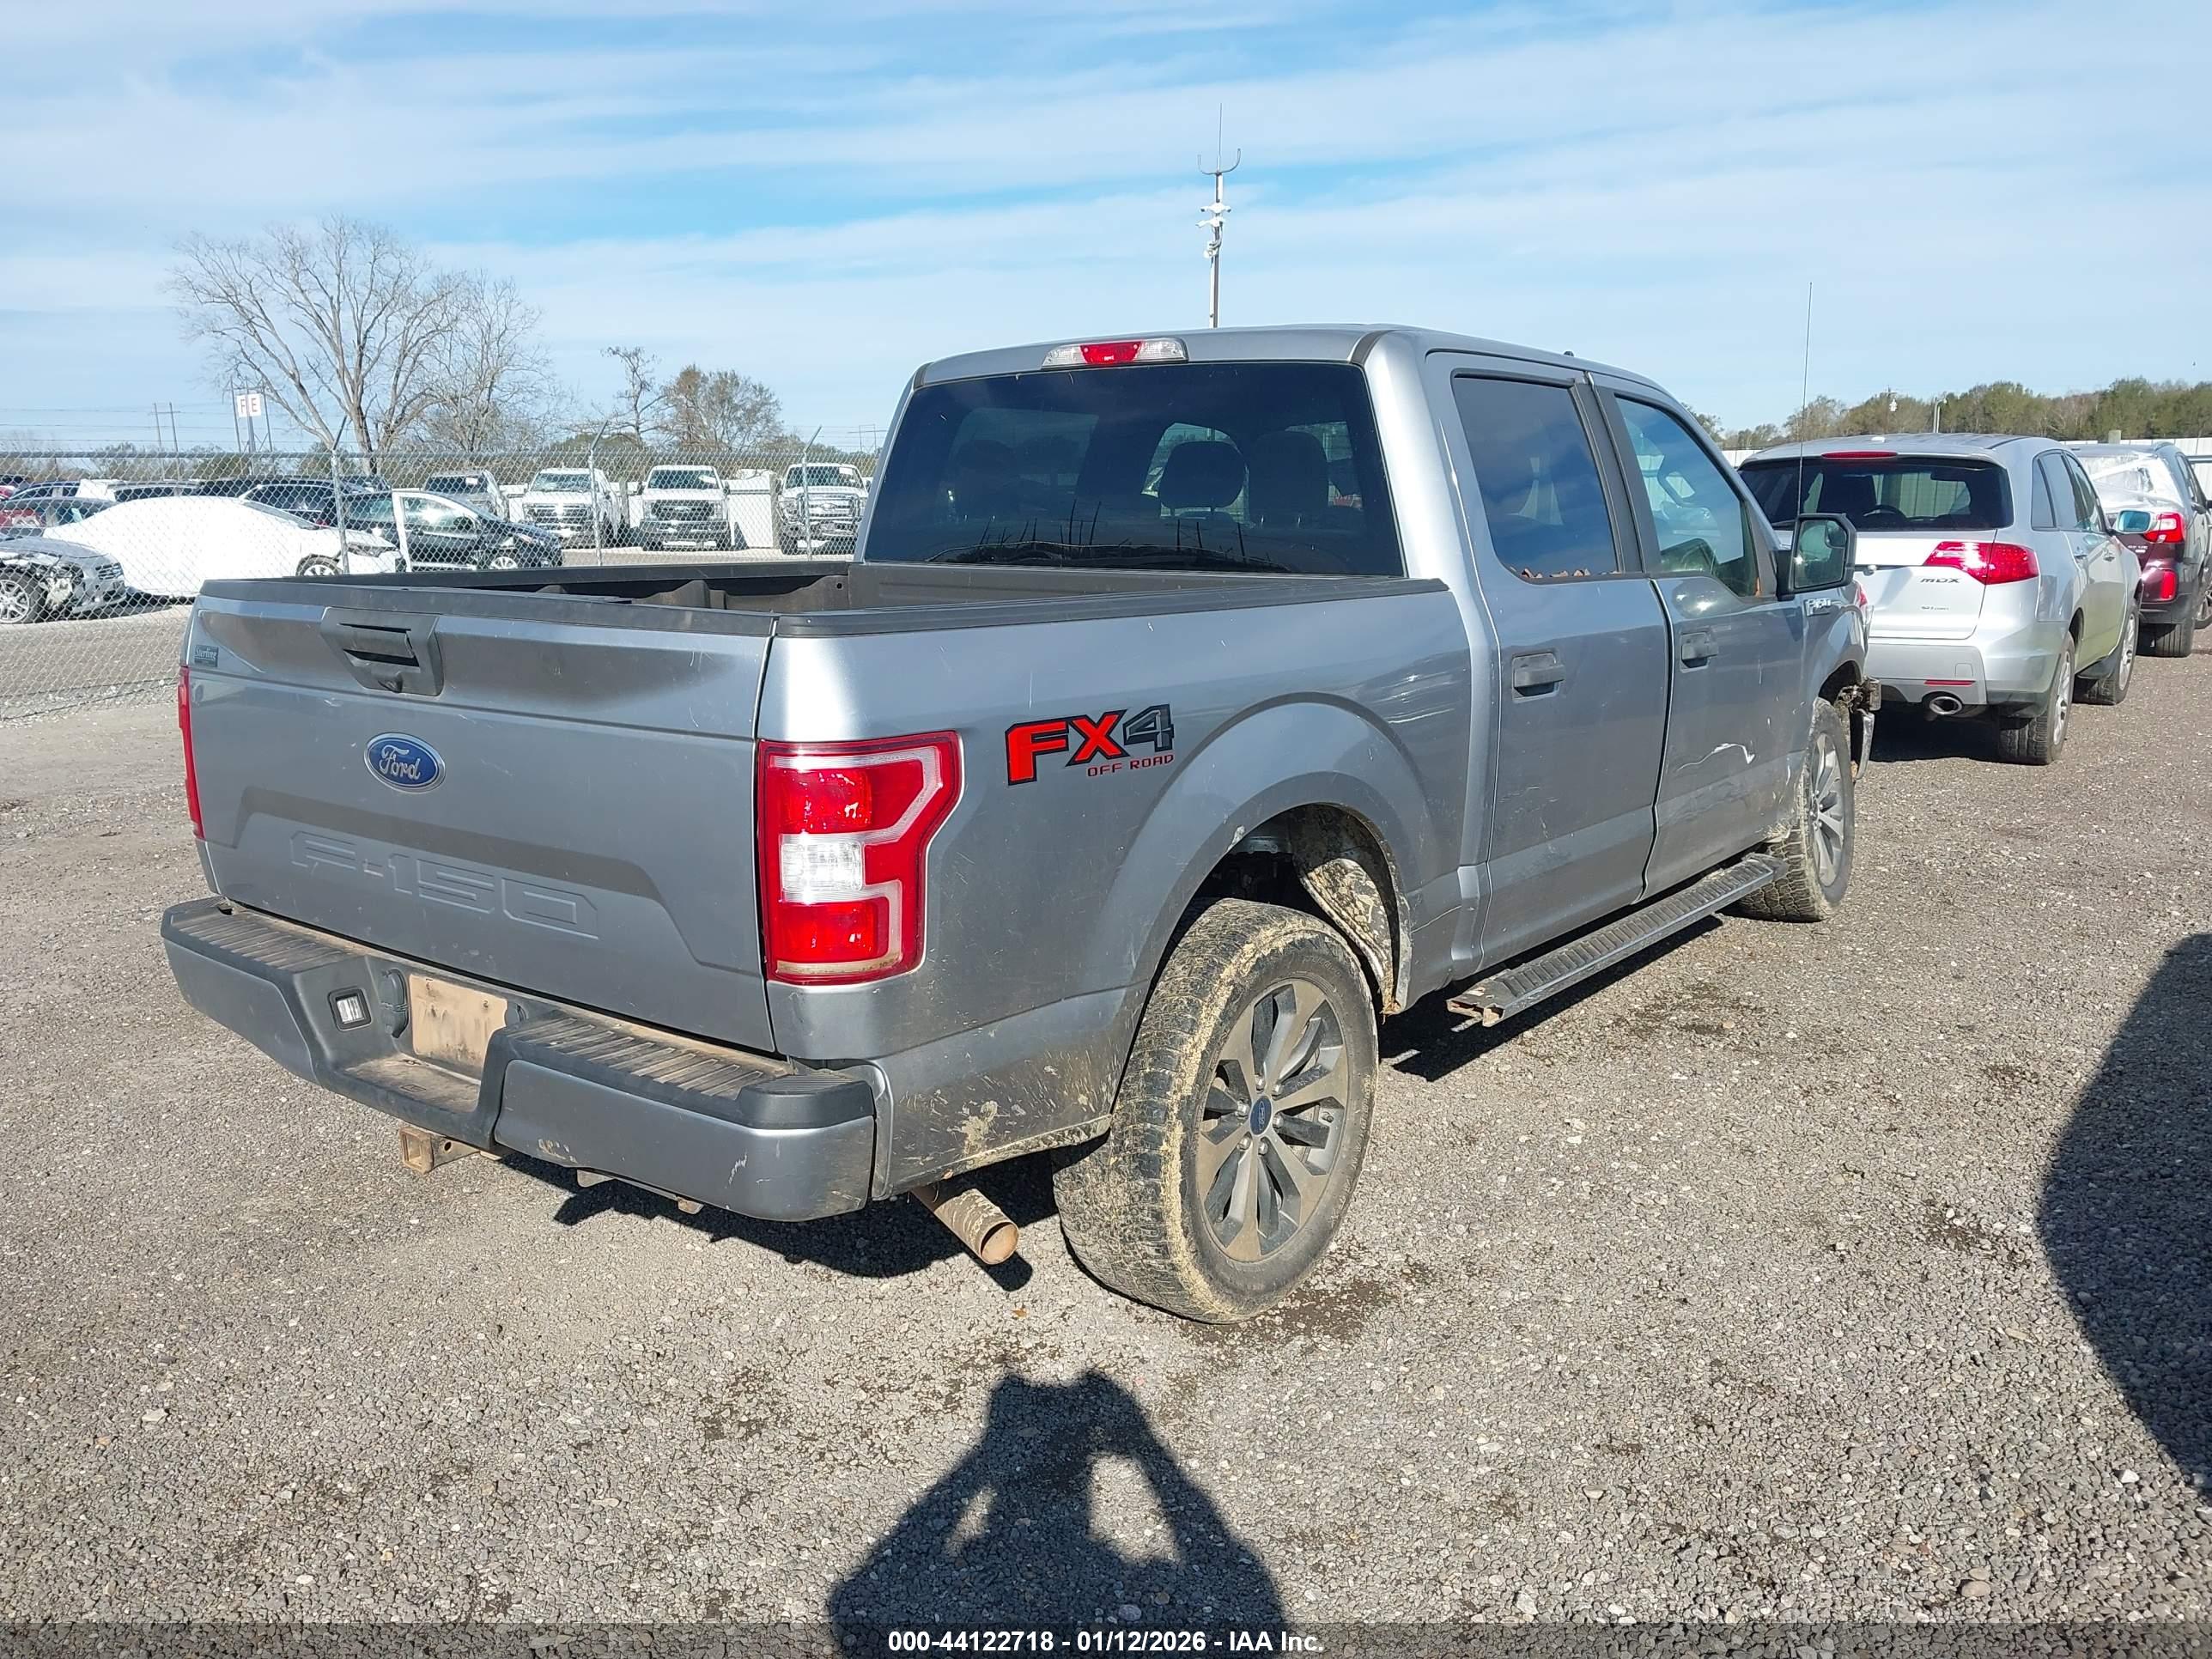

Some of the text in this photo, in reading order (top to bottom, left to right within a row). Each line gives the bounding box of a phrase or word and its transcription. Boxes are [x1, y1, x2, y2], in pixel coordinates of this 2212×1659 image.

[379, 744, 421, 781] Ford
[1005, 703, 1175, 787] FX4
[1086, 753, 1175, 778] OFF ROAD
[289, 830, 600, 940] F-150
